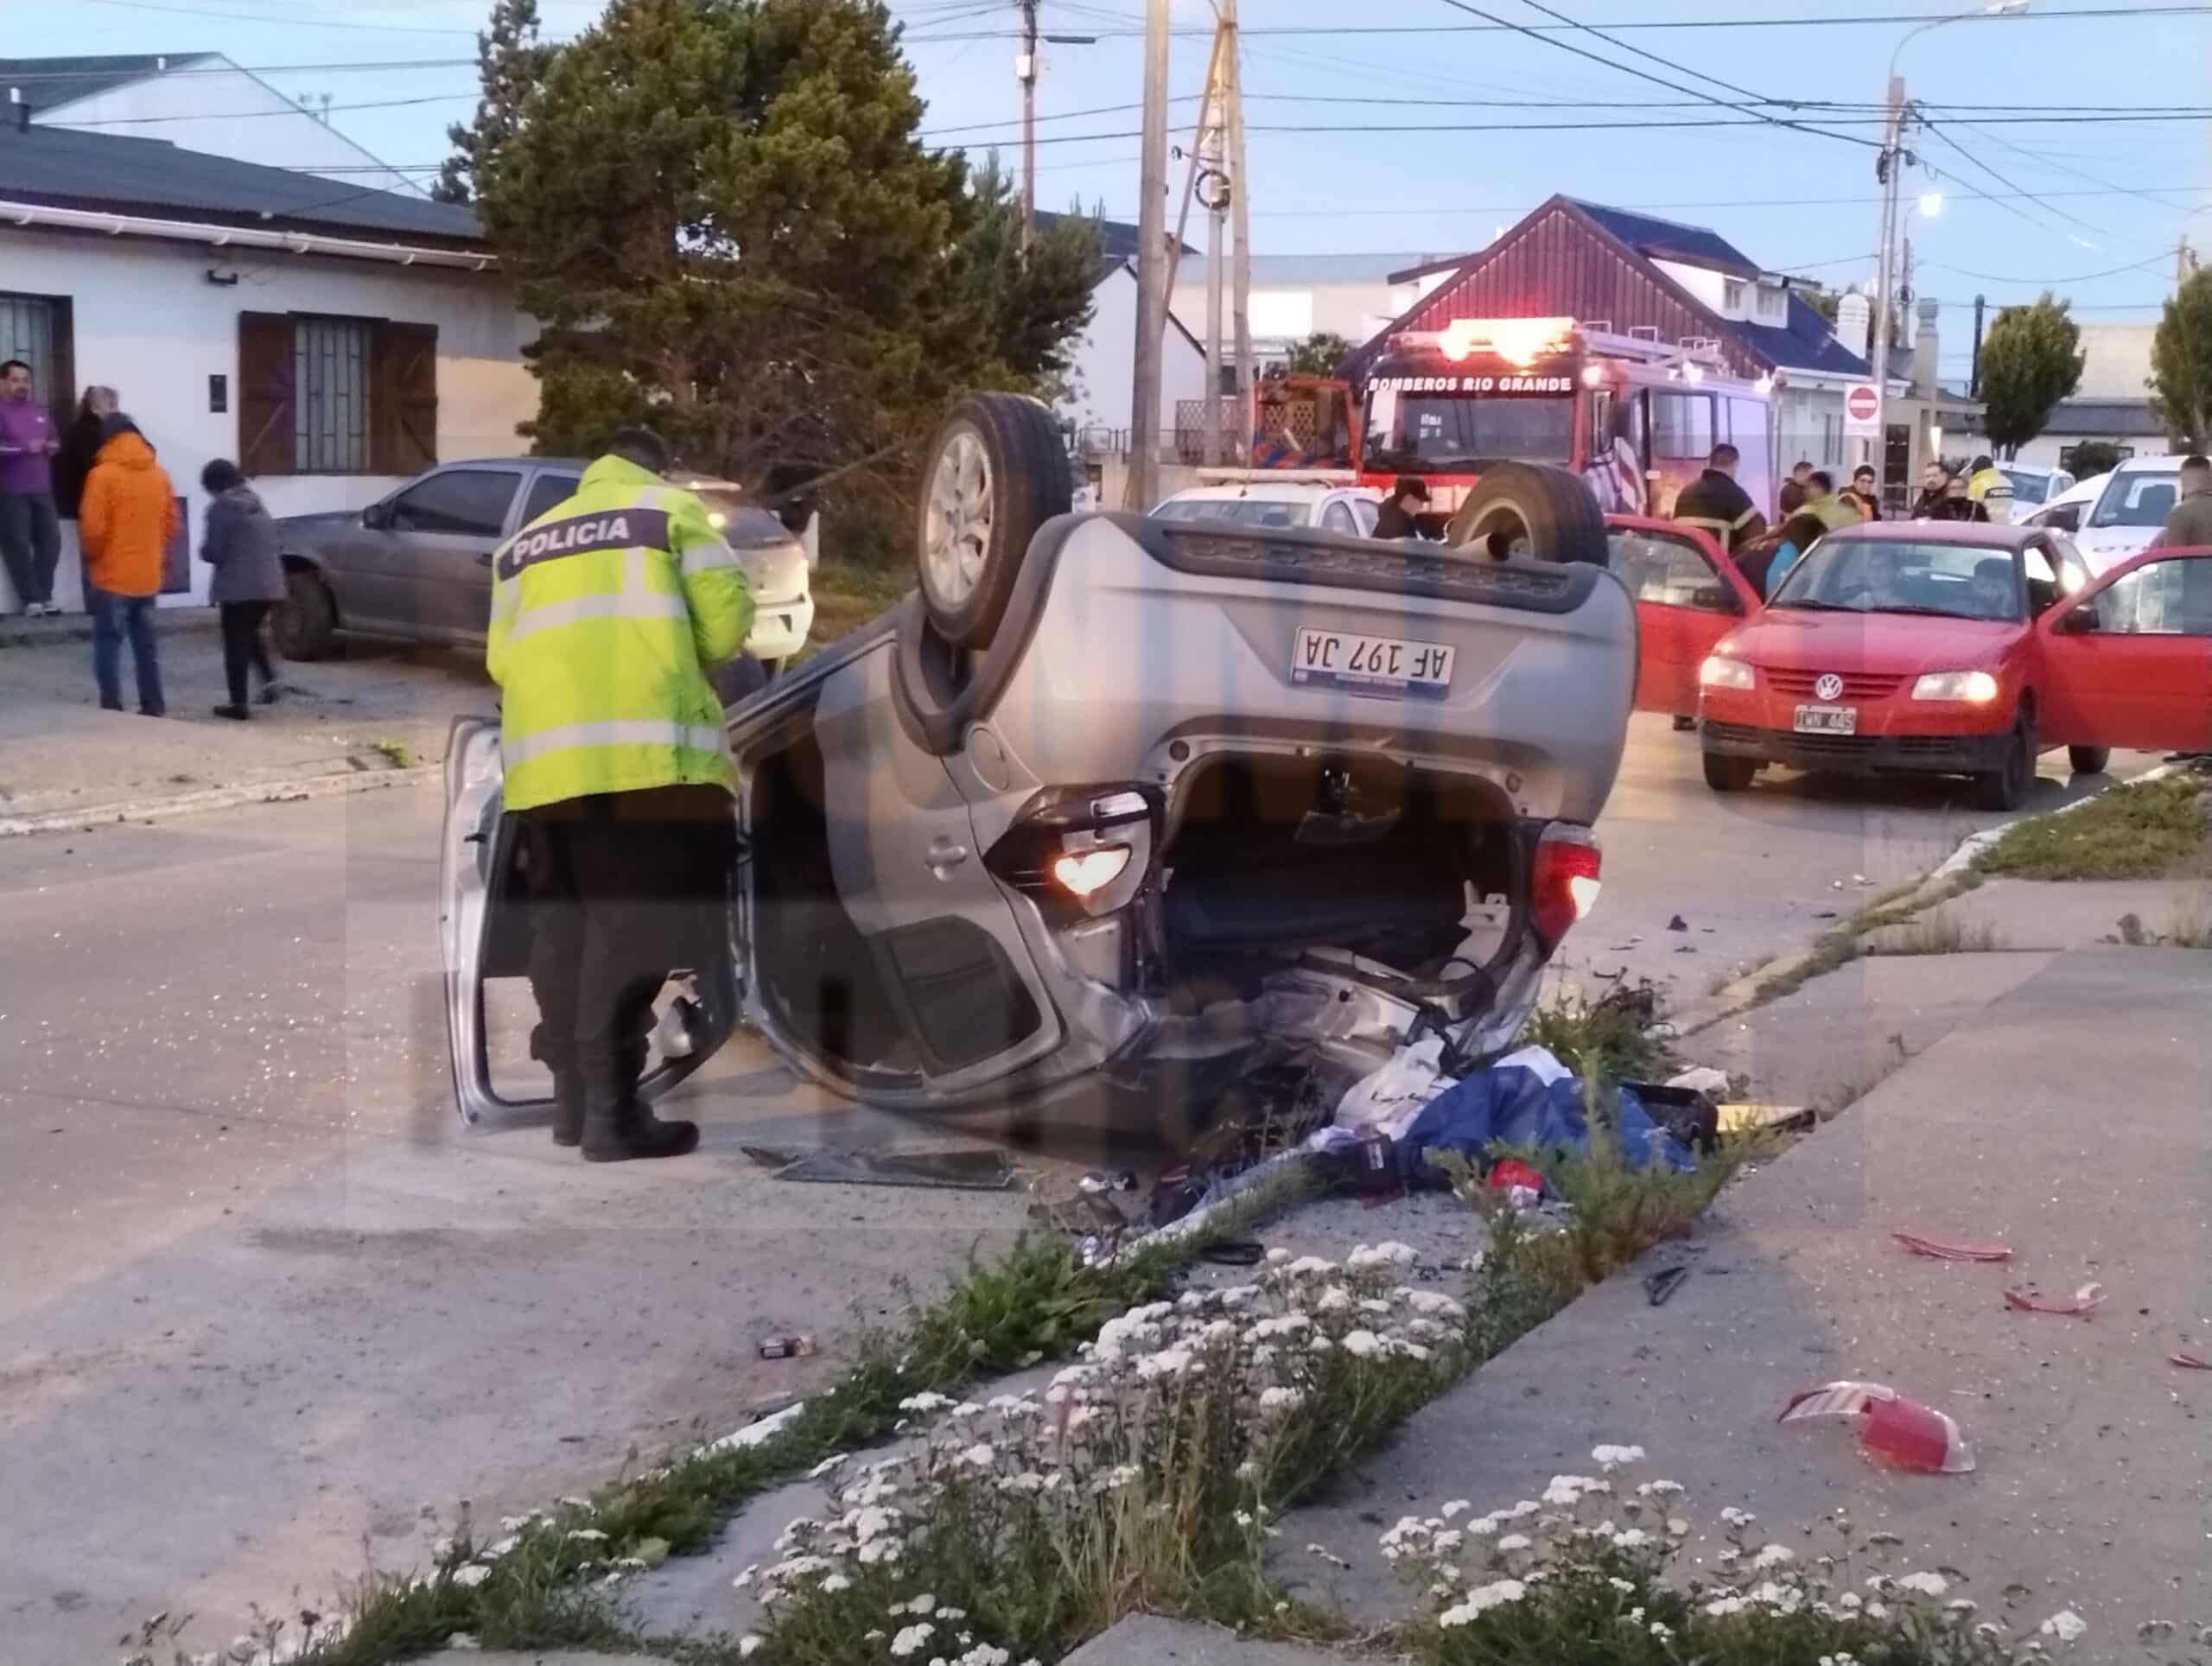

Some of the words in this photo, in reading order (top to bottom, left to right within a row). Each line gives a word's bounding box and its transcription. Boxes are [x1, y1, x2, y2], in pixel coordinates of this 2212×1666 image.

[1369, 377, 1458, 391] BOMBEROS
[1462, 377, 1494, 391] RIO
[1498, 377, 1572, 391] GRANDE
[512, 517, 630, 565] POLICIA
[1306, 635, 1340, 668] JA
[1348, 640, 1404, 675] 197
[1410, 648, 1447, 679] AF
